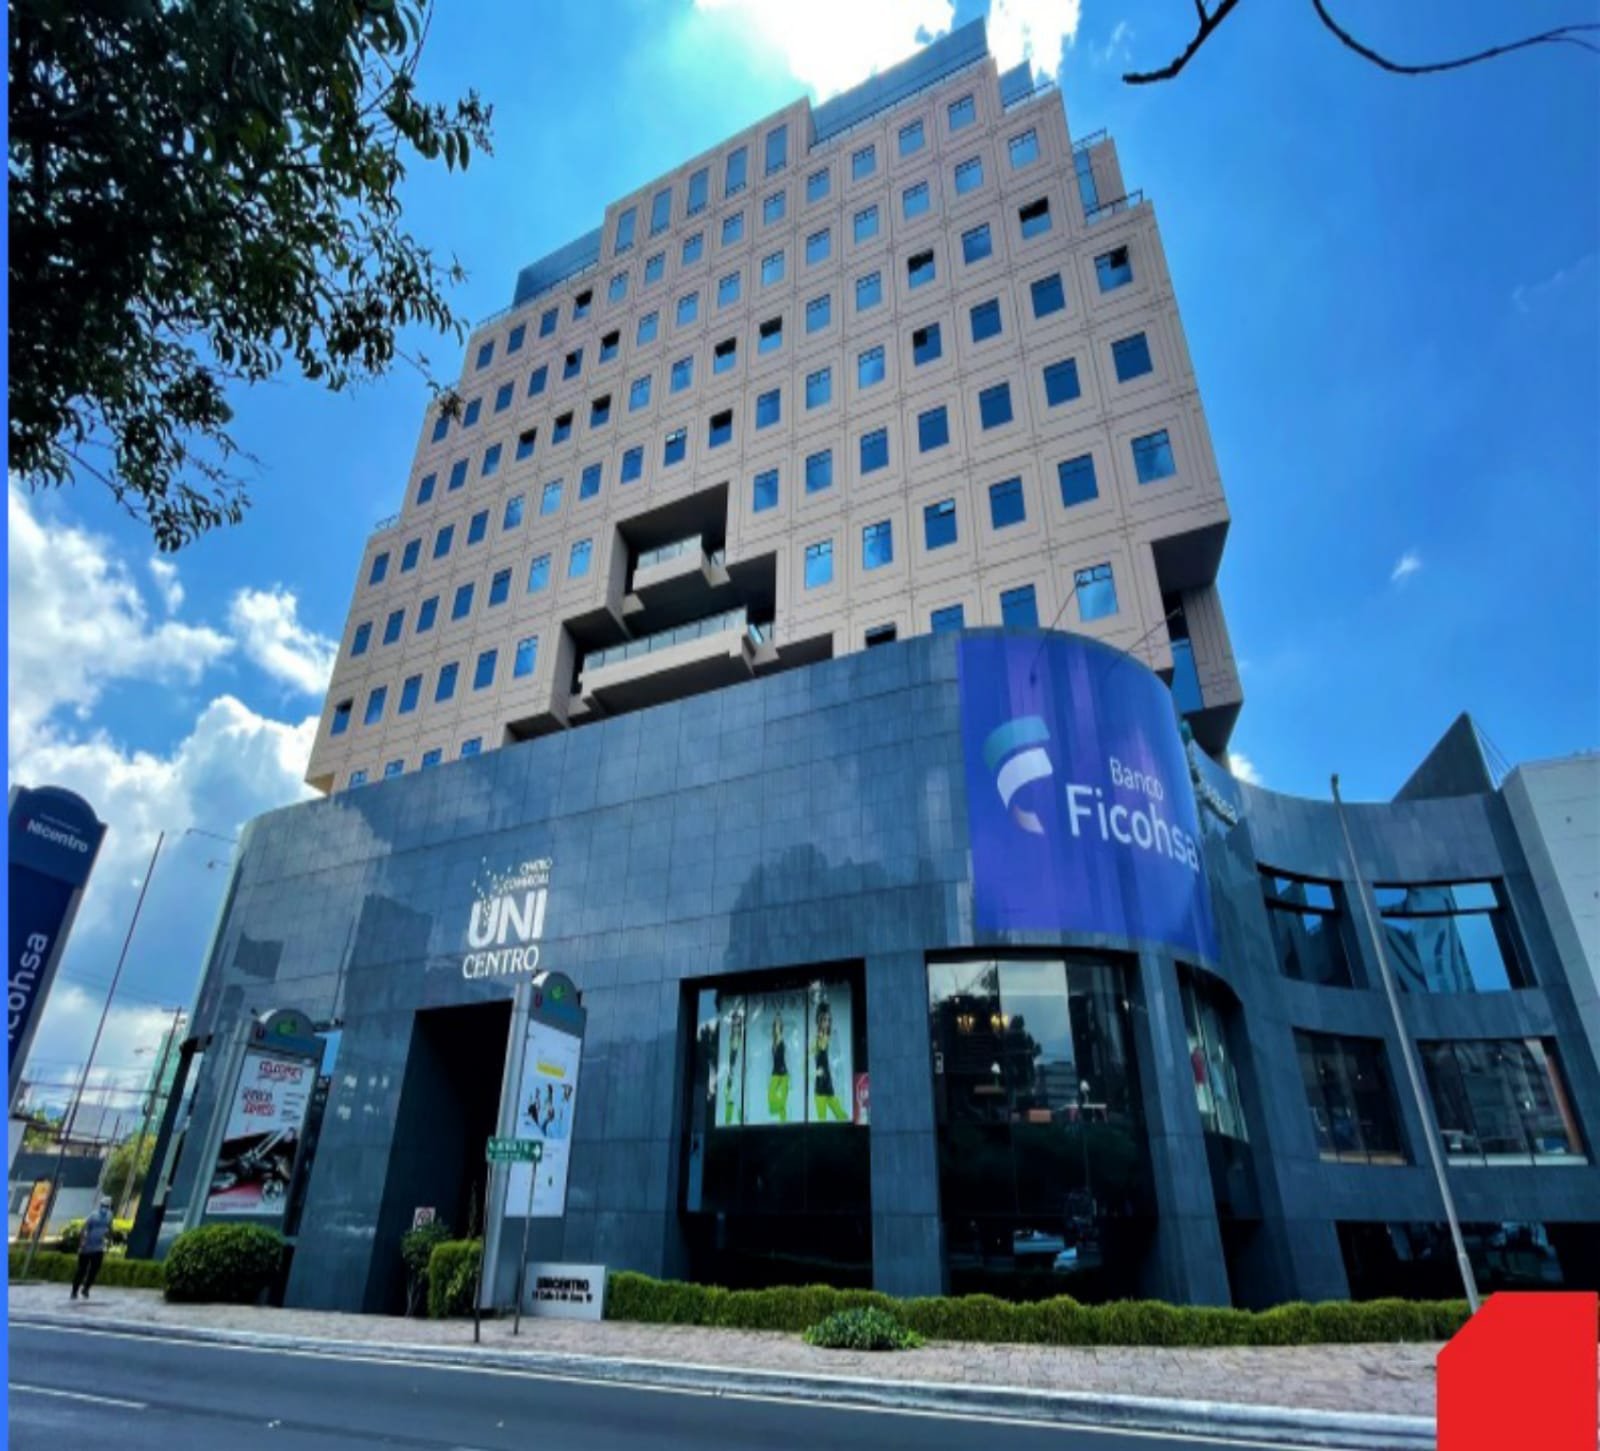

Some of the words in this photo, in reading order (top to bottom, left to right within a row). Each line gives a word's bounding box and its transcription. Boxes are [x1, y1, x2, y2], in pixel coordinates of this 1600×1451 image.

[1109, 756, 1164, 801] Banco
[1065, 783, 1200, 872] Ficohsa
[468, 888, 548, 949] UNI
[462, 944, 540, 979] CENTRO
